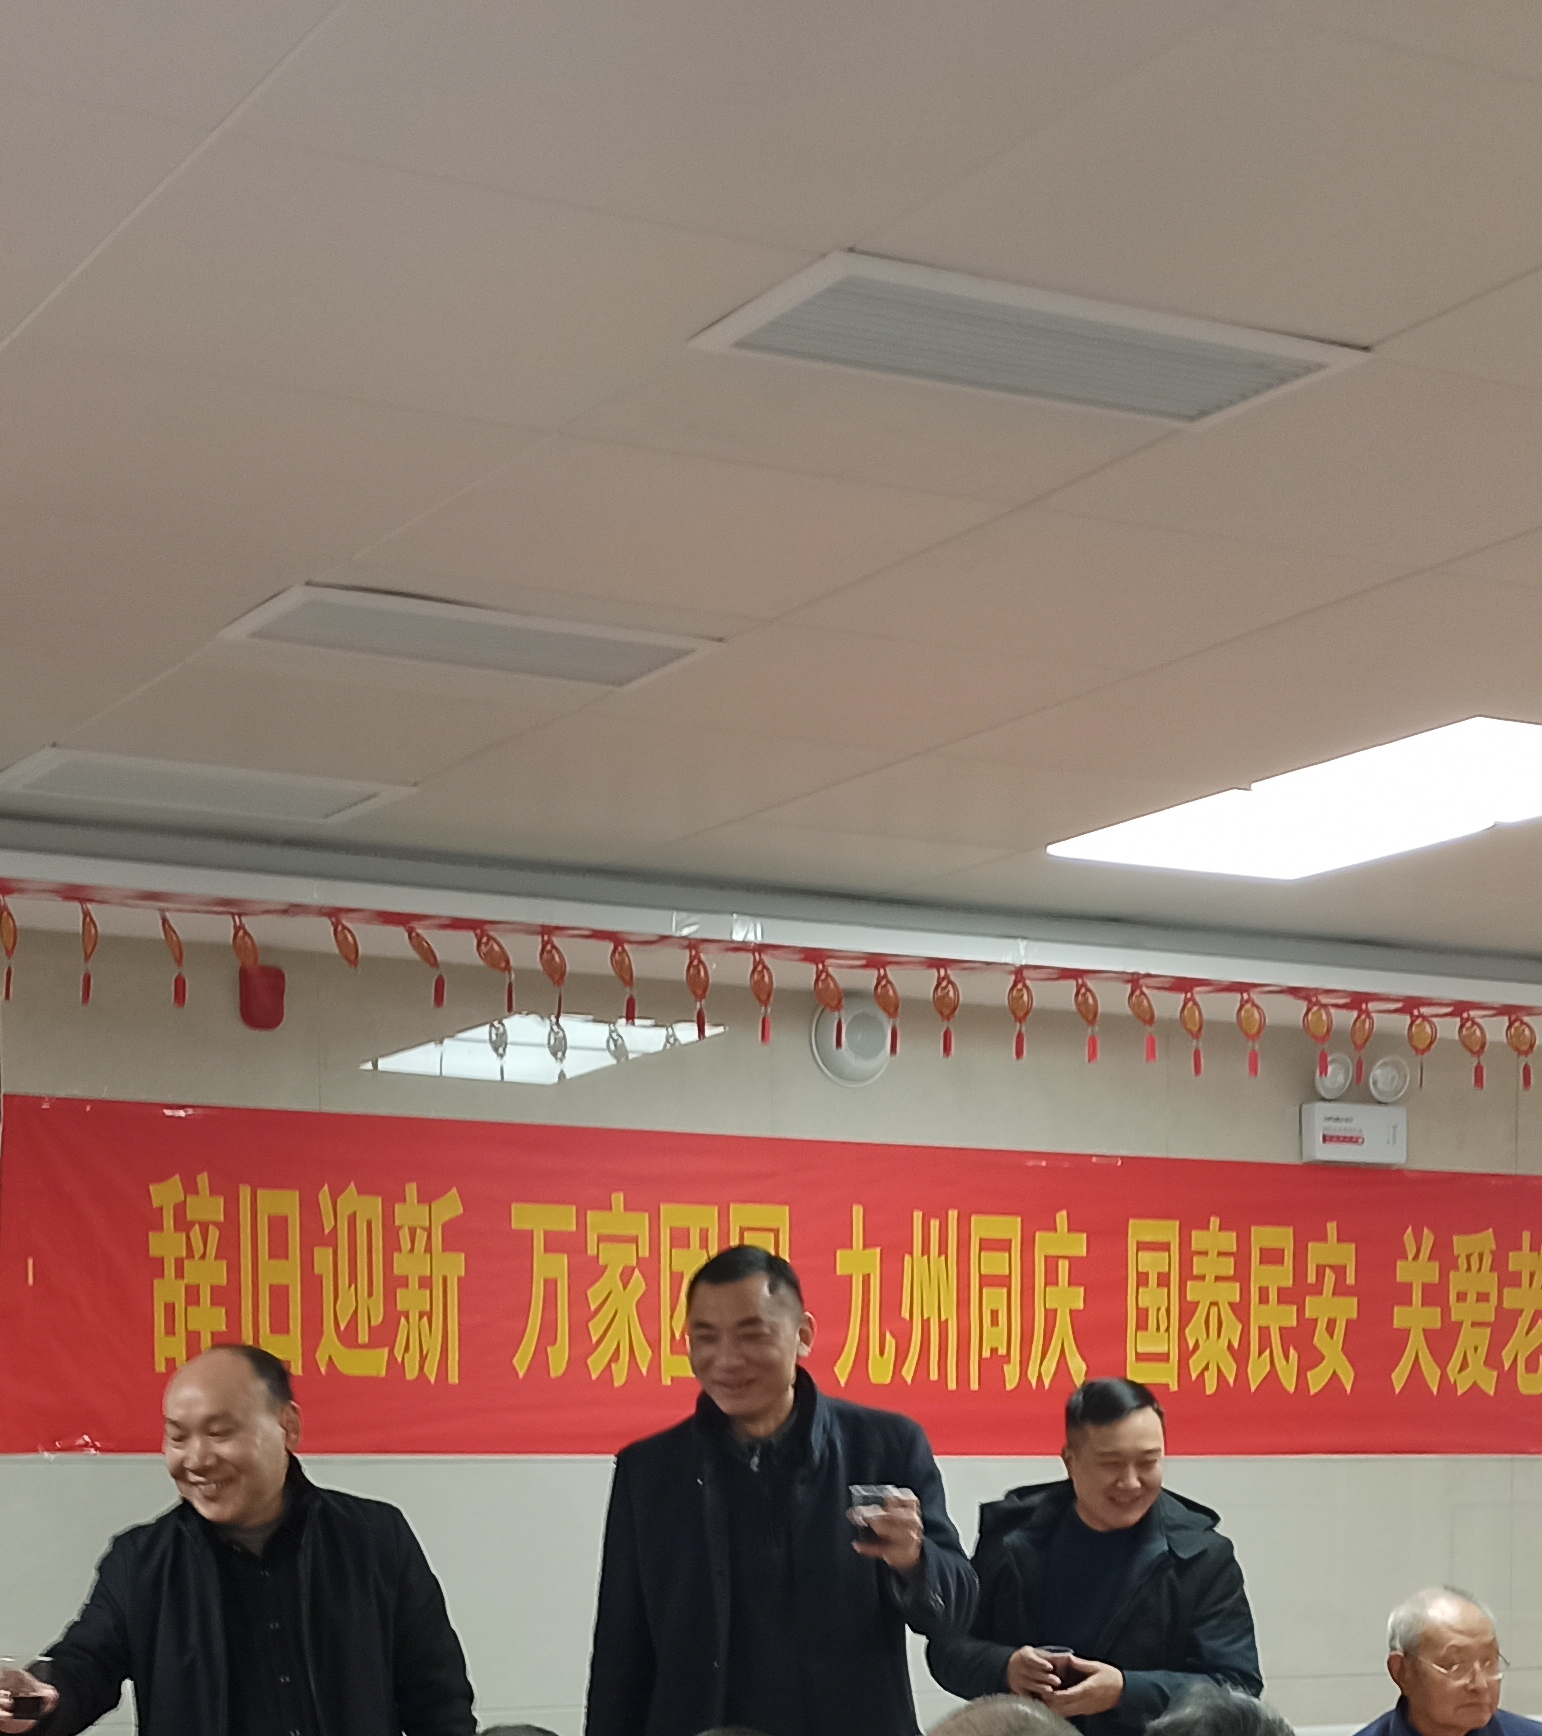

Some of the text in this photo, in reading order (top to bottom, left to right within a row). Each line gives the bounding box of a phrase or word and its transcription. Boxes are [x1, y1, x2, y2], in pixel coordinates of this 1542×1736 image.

[149, 1172, 466, 1385] 辞旧迎新
[834, 1203, 1087, 1391] 九州同庆
[1126, 1216, 1357, 1396] 国泰民安
